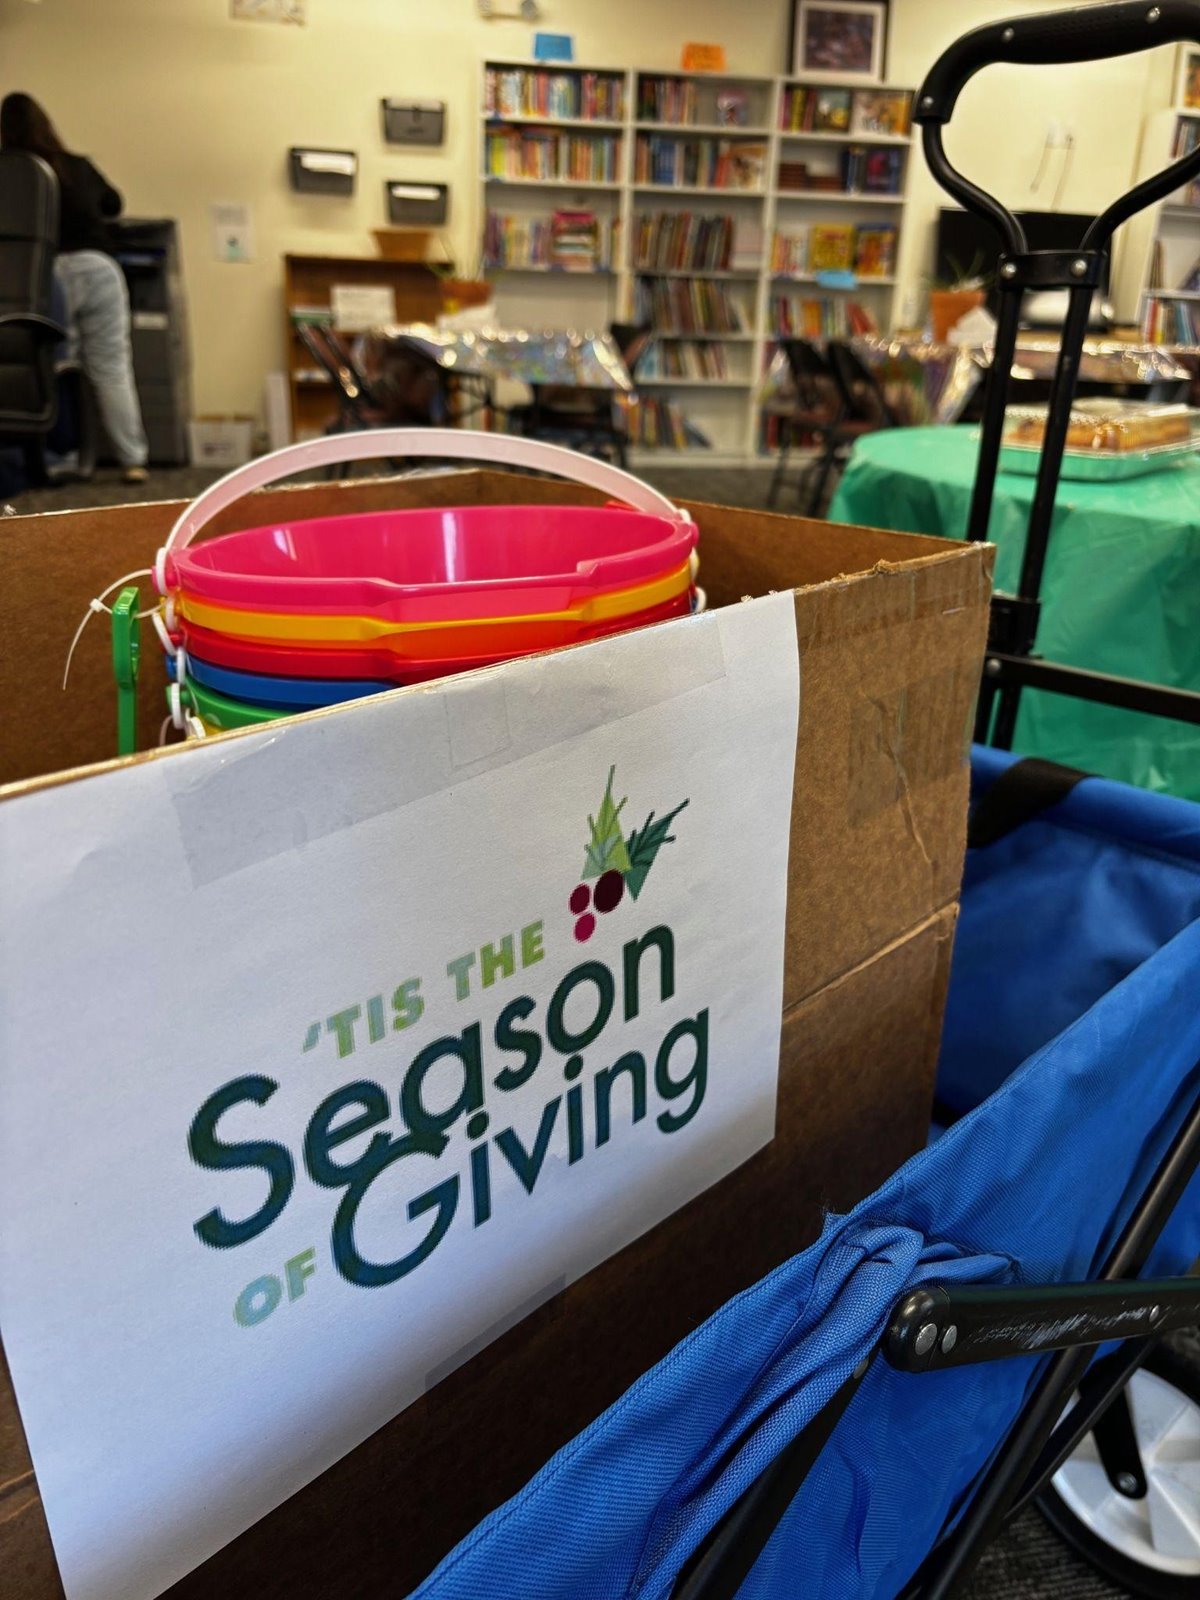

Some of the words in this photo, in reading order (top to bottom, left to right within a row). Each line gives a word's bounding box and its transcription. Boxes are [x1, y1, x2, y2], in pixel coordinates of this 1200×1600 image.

[187, 924, 675, 1250] Season
[446, 919, 545, 1002] THE
[232, 1247, 316, 1329] OF
[331, 1007, 710, 1289] Giving
